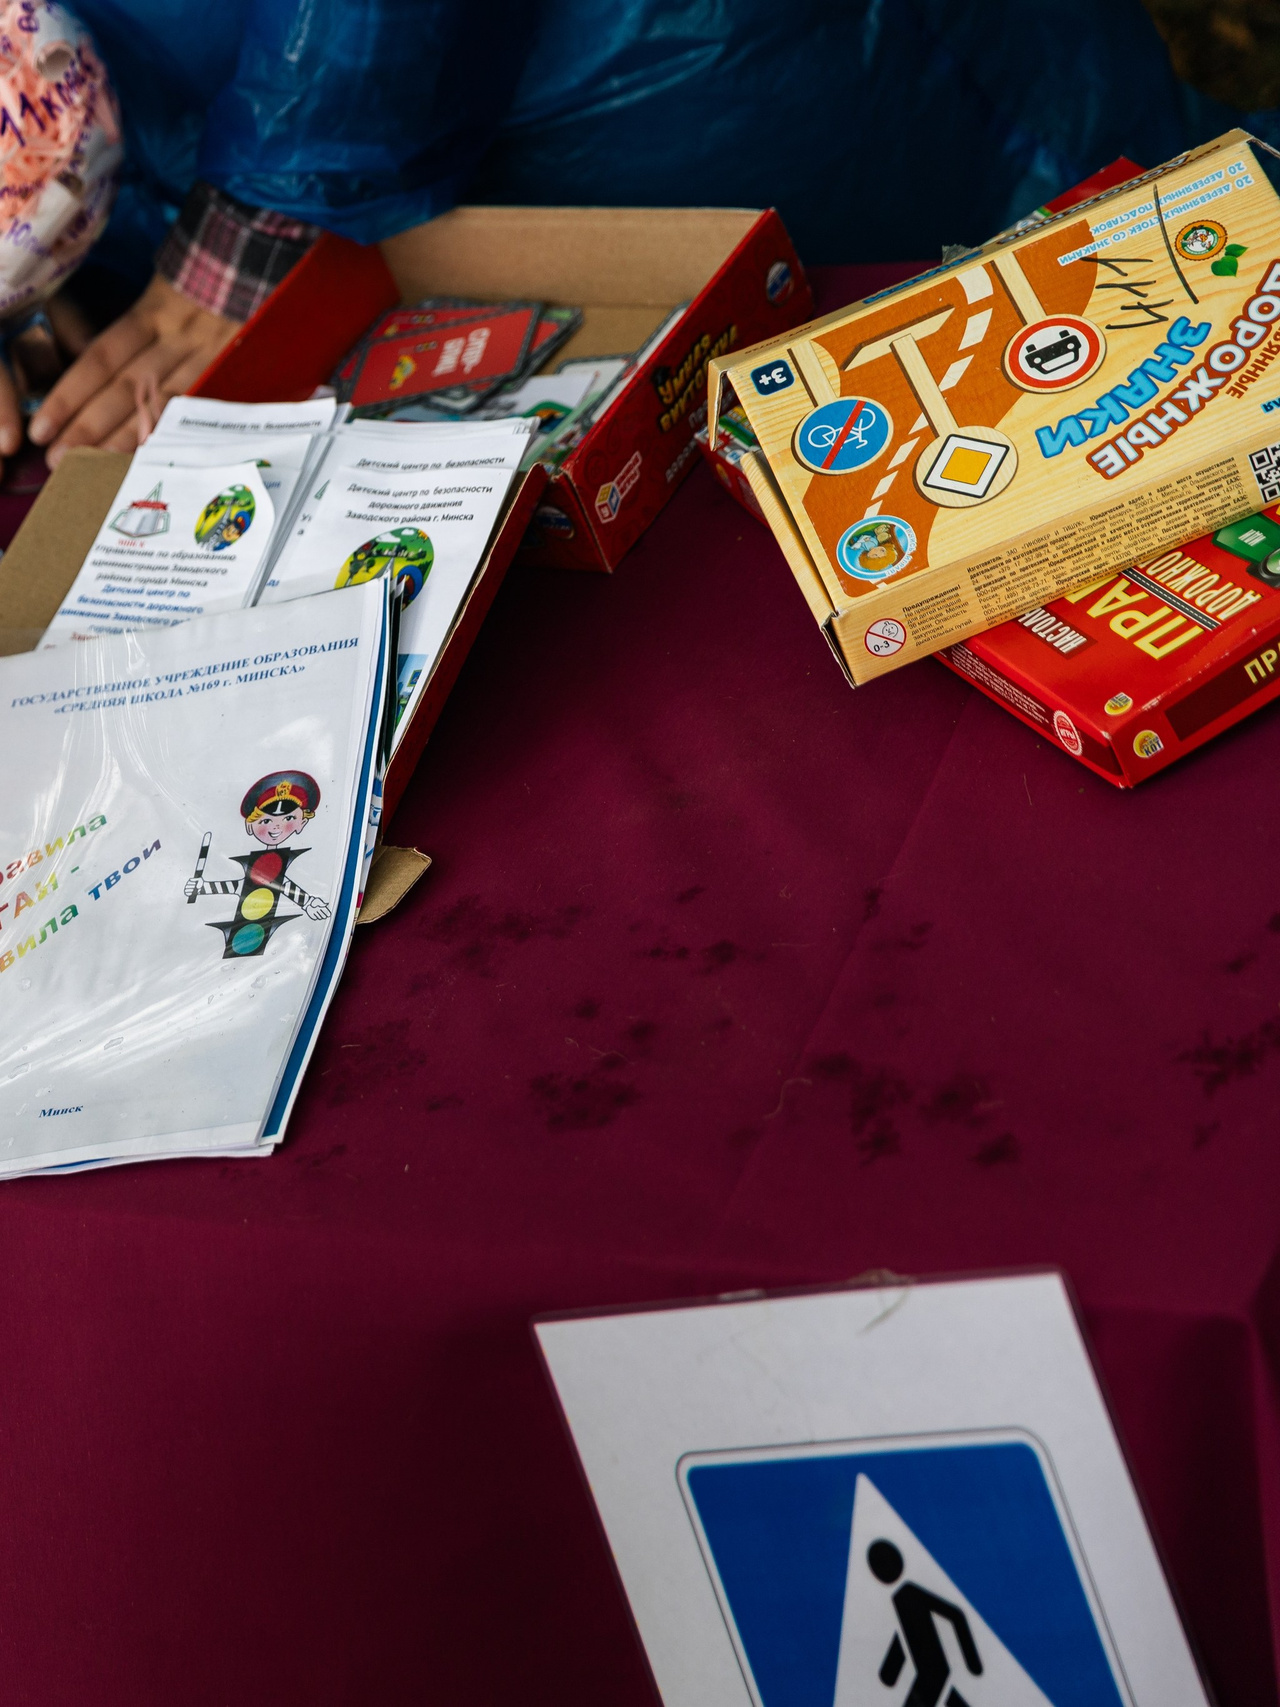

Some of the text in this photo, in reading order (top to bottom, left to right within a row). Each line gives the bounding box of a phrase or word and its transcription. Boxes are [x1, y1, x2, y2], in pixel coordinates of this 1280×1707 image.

[1227, 161, 1244, 175] 20
[1234, 174, 1252, 188] 20
[1089, 201, 1153, 236] ПОДСТАВОК
[1127, 215, 1160, 235] СТОЕК
[1111, 229, 1126, 242] СО
[1057, 237, 1110, 266] ЗНАКАМИ
[759, 367, 787, 386] 3+
[1035, 316, 1212, 458] ЗНАКИ
[357, 456, 505, 471] Детский центр по безопасности
[347, 483, 493, 498] Детский центр по безопасности
[369, 498, 463, 510] дорожного движения
[1073, 524, 1106, 543] электронной
[1195, 468, 1239, 491] Уполномоченная
[1201, 501, 1231, 517] территории
[345, 510, 400, 523] Заводского
[400, 512, 431, 524] района
[442, 512, 474, 522] Минска
[966, 553, 1003, 573] Изготовитель:
[1005, 547, 1017, 556] ЗАО
[1088, 502, 1124, 521] Юридический
[1127, 494, 1144, 505] адрес
[1155, 482, 1172, 493] адрес
[1175, 474, 1192, 485] места
[1194, 456, 1234, 477] осуществления
[969, 560, 1004, 580] деятельности
[1012, 542, 1048, 561] изготовлению
[1077, 517, 1108, 534] Республика
[1225, 462, 1237, 471] дом
[973, 574, 1006, 592] организация
[1018, 555, 1049, 573] претензиям
[1061, 536, 1096, 555] потребителей
[1109, 520, 1132, 534] качеству
[1135, 508, 1163, 524] продукции
[1175, 490, 1205, 507] территории
[1207, 482, 1223, 493] стран
[1004, 575, 1037, 593] Московская
[1071, 551, 1094, 565] рабочий
[1219, 494, 1231, 503] дом
[1047, 548, 1083, 567] Юридический
[1083, 541, 1100, 553] адрес
[1105, 532, 1122, 543] адрес
[1122, 525, 1140, 536] места
[1140, 507, 1182, 529] осуществления
[1055, 567, 1090, 586] Юридический
[1137, 551, 1262, 620] ДОРОЖНО
[147, 602, 204, 615] дорожного
[873, 640, 892, 655] 0-3
[11, 637, 359, 708] ГОСУДАРСТВЕННОЕ УЧРЕЖДЕНИЕ ОБРАЗОВАНИЯ
[131, 686, 184, 706] ШКОЛА
[186, 678, 220, 697] №169
[223, 678, 232, 688] г.
[236, 664, 306, 685] МИНСКА»
[88, 839, 162, 901] твои
[38, 1105, 84, 1118] Минск
